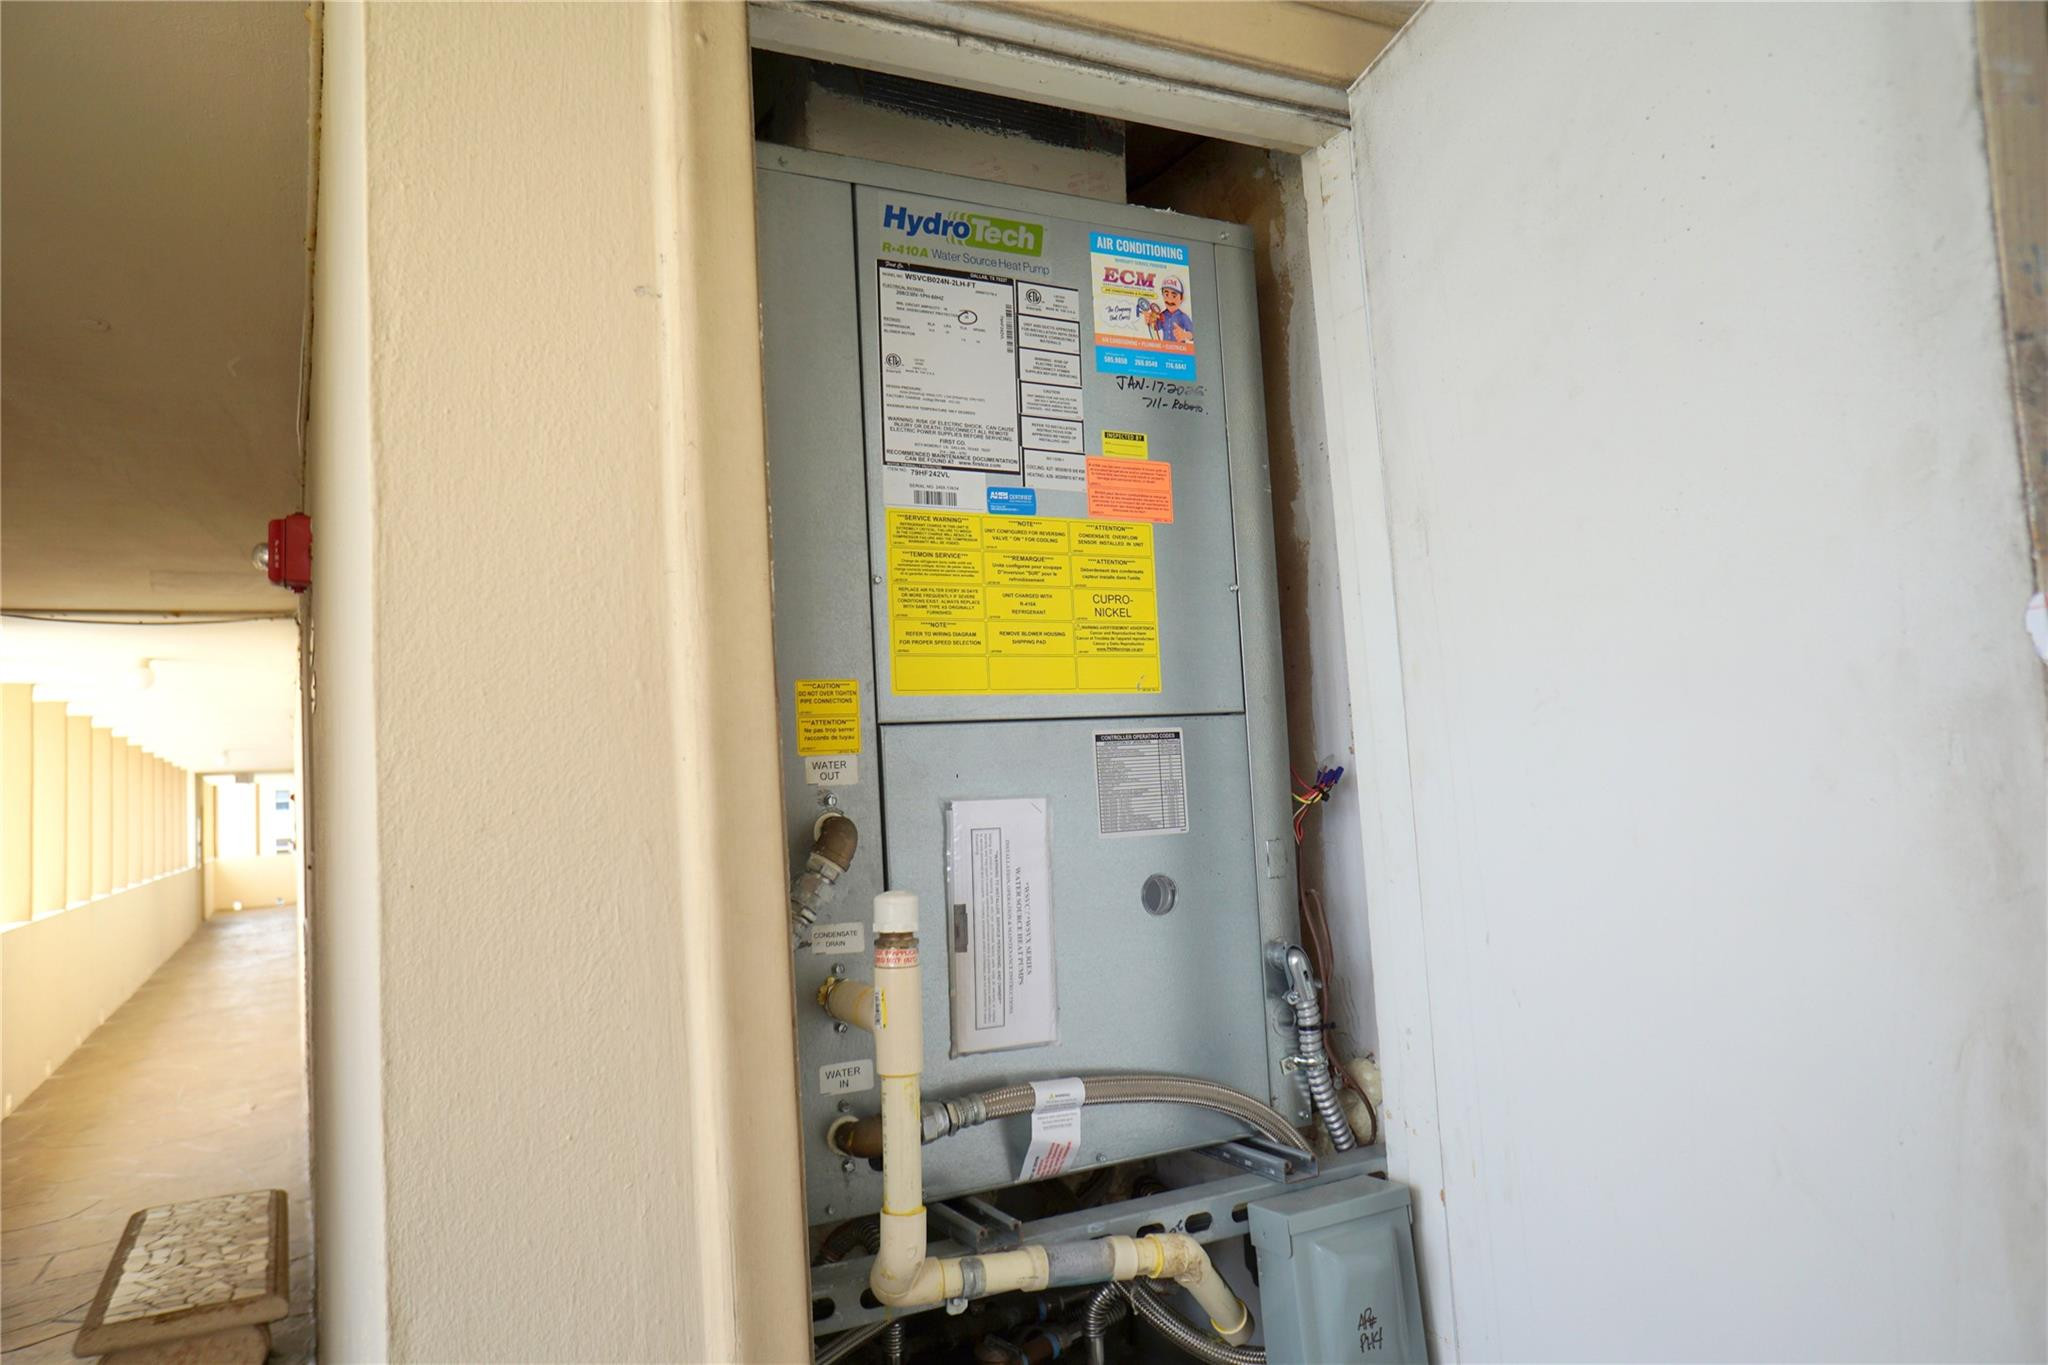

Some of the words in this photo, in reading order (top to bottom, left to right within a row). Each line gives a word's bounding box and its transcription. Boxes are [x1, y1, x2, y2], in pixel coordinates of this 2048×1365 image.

[1097, 237, 1113, 251] AIR
[1116, 239, 1183, 260] CONDITIONING
[882, 242, 929, 258] R-410A
[931, 249, 960, 262] Water
[963, 254, 997, 268] Source
[998, 261, 1021, 271] Heat
[1023, 264, 1049, 275] Pump
[905, 272, 976, 288] WSVCB024N-2LH-FT
[1103, 266, 1156, 289] ECM
[1092, 593, 1133, 605] CUPRO-
[1094, 608, 1131, 618] NICKEL
[812, 760, 847, 770] WATER
[819, 771, 840, 781] OUT
[1015, 867, 1023, 897] WATER
[813, 930, 858, 939] CONDENSATE
[825, 1066, 861, 1080] WATER
[839, 1079, 849, 1088] IN
